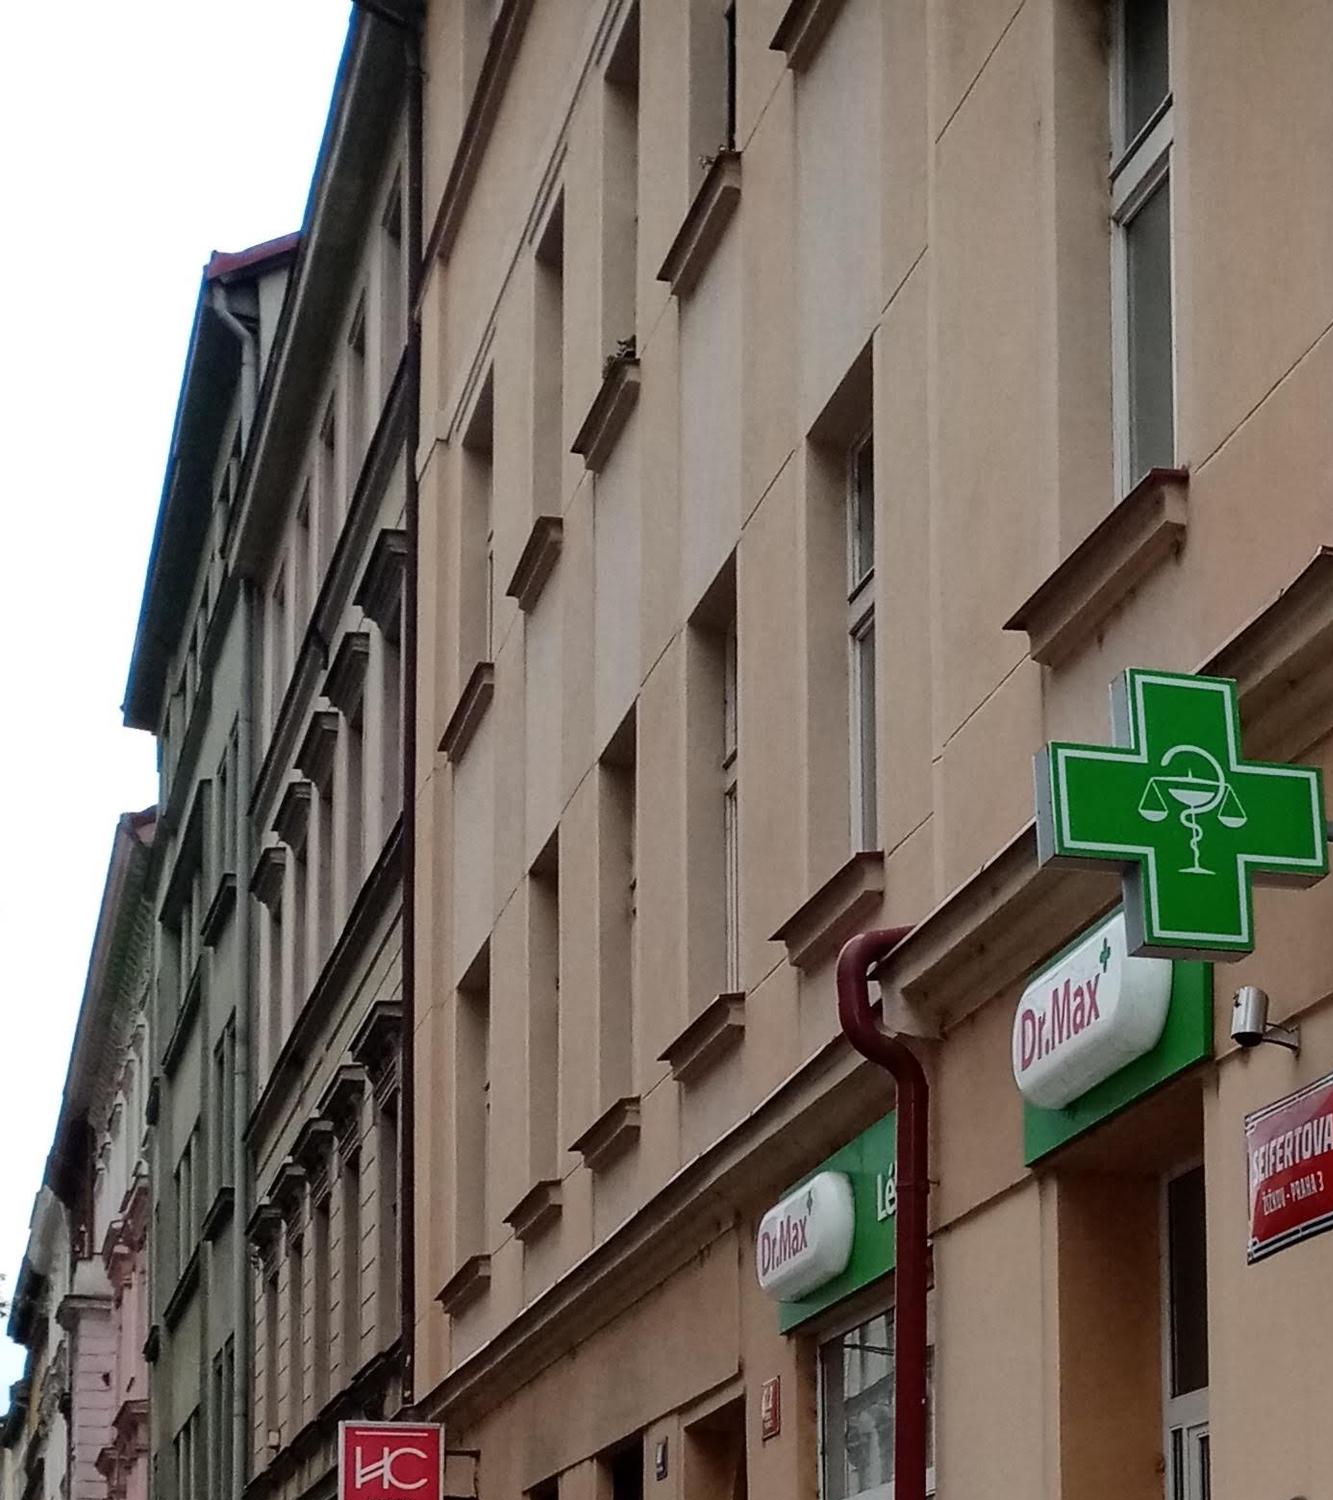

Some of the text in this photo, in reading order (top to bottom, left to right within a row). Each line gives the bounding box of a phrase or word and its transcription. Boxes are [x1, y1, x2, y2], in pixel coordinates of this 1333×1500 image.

[1021, 973, 1101, 1073] Dr.Max
[1316, 1171, 1325, 1192] 3
[760, 1214, 808, 1277] Dr.Max
